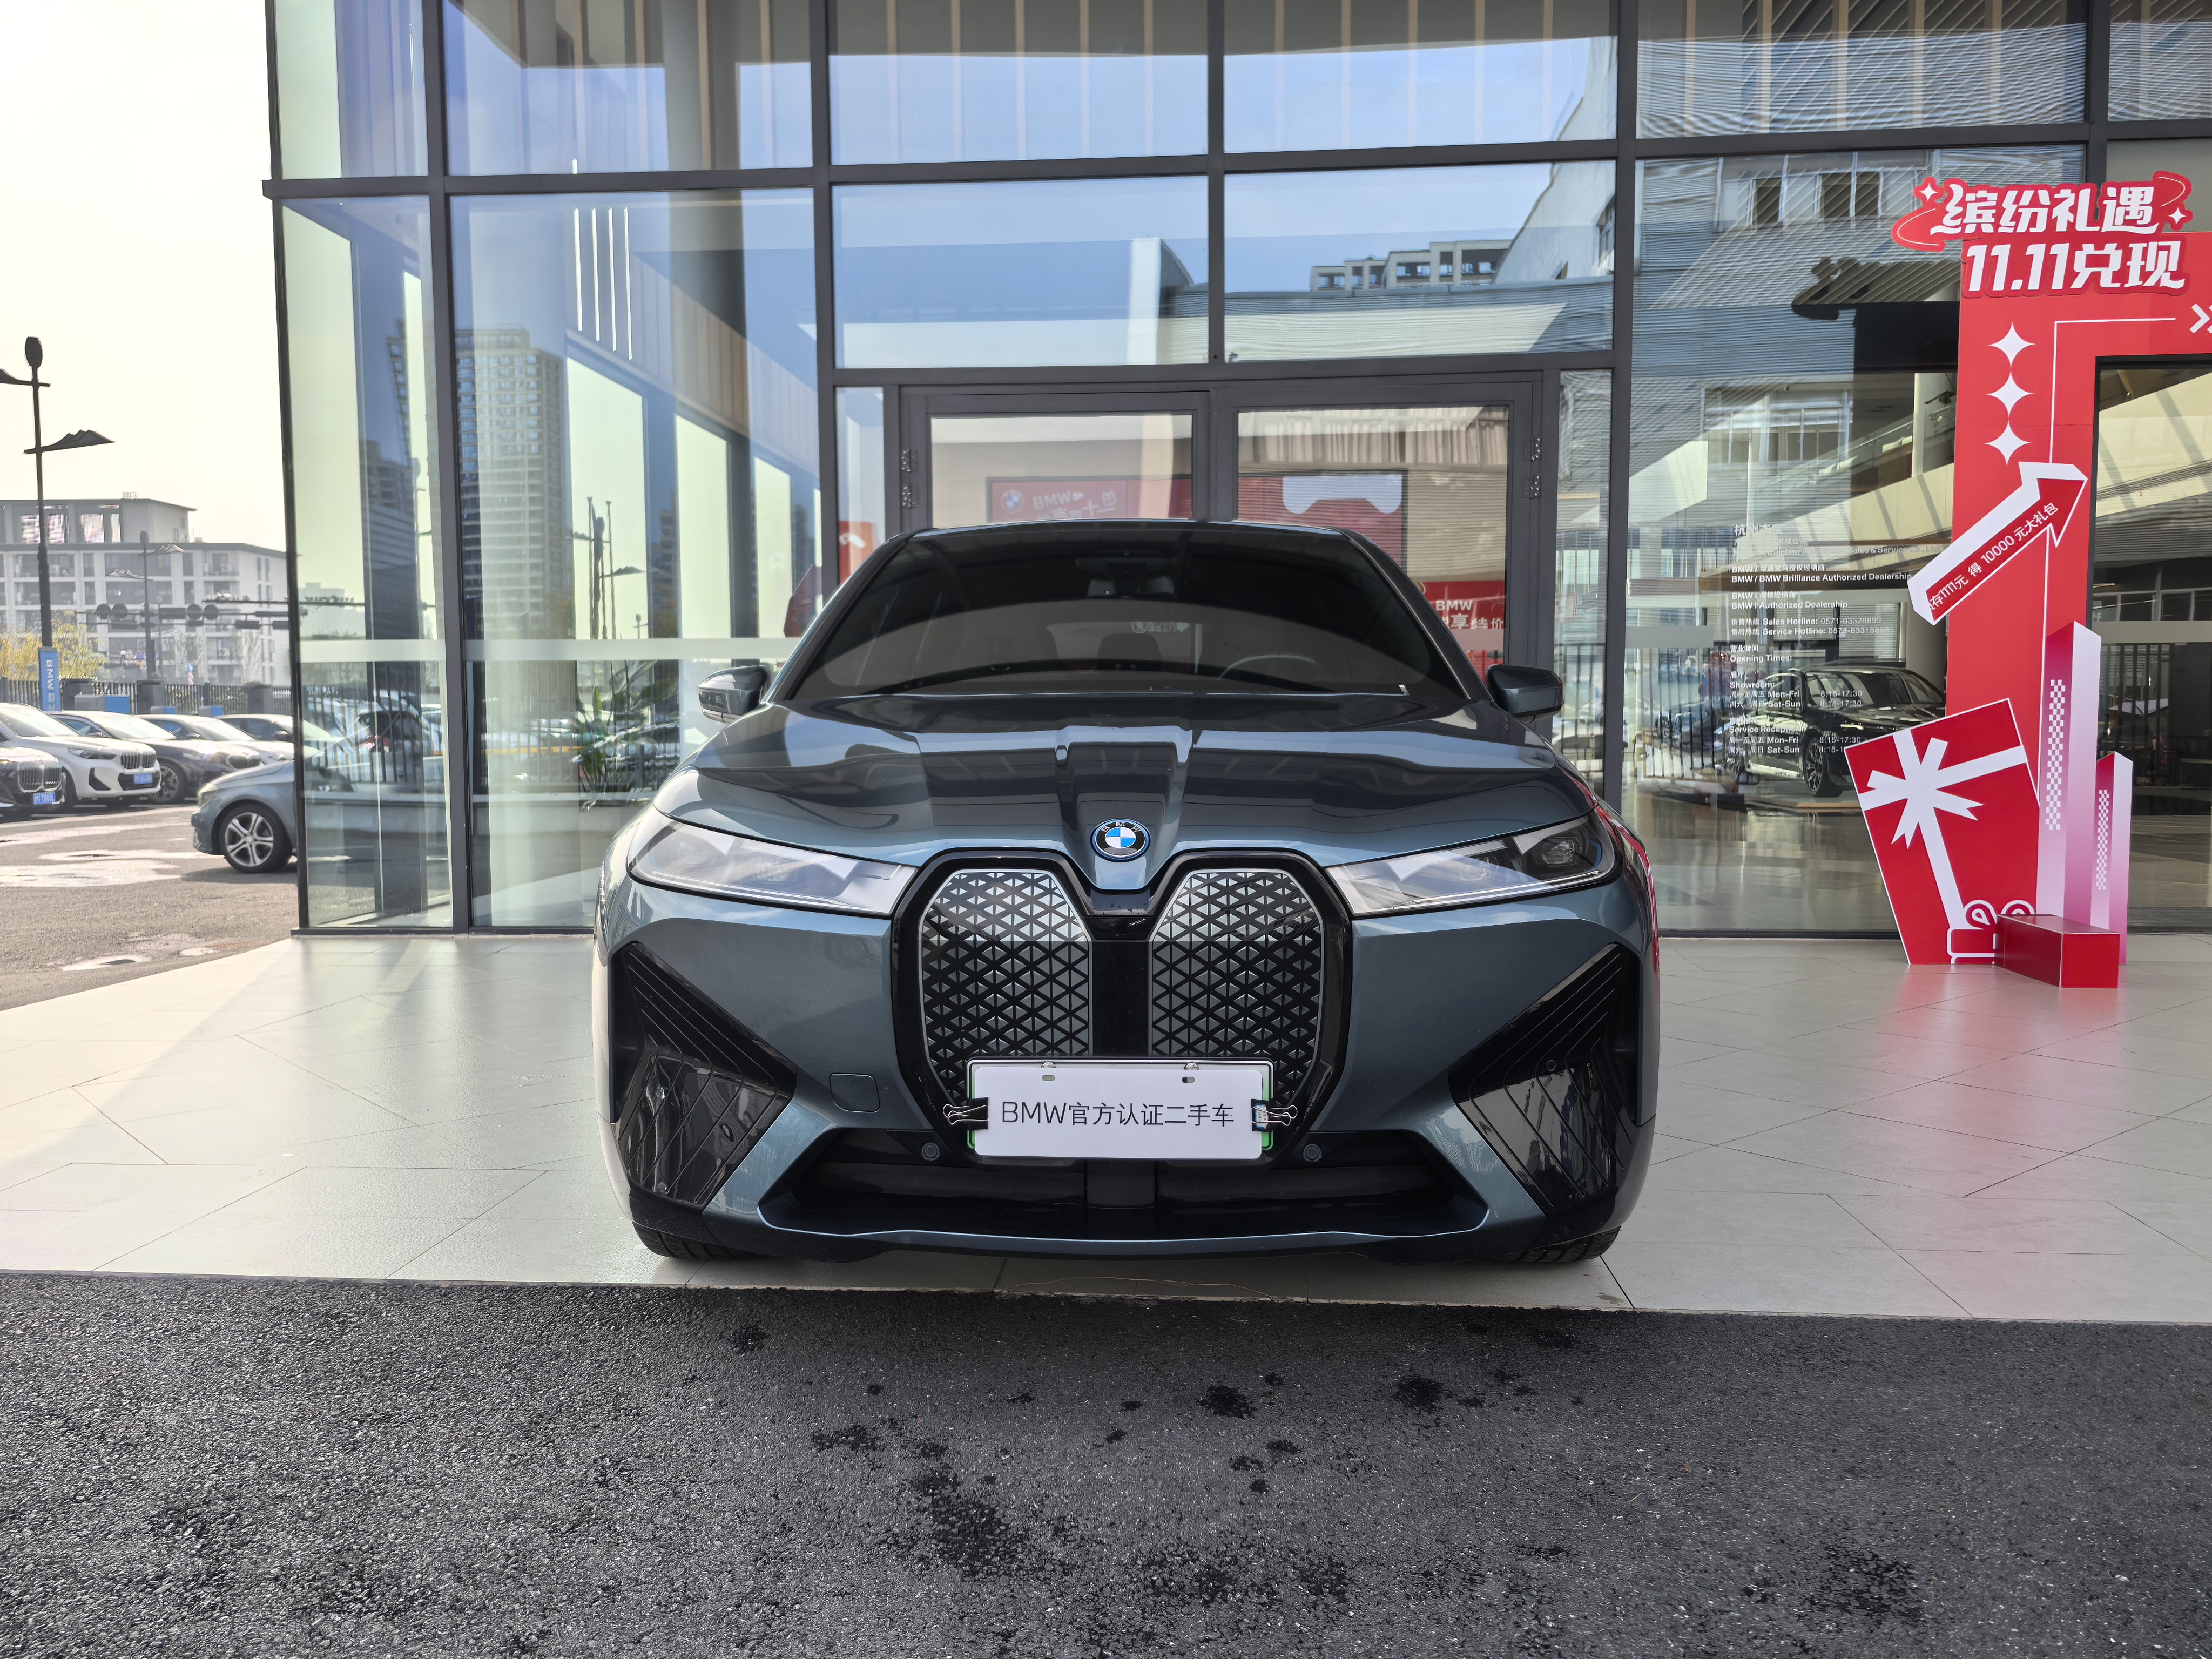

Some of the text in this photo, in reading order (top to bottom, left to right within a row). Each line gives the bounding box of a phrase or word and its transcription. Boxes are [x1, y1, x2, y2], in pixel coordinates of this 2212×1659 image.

[1930, 184, 2159, 234] 缤纷礼遇
[1966, 241, 2185, 291] 11.11兑现
[1033, 490, 1071, 510] BMW
[1930, 503, 2058, 610] 存1111元 得 10000 元大礼包
[1759, 575, 1781, 583] BMW
[1783, 574, 1820, 582] Brilliance
[1822, 573, 1866, 582] Authorized
[1435, 599, 1473, 611] BMW
[1759, 601, 1803, 609] Authorized
[1805, 600, 1848, 609] Dealership
[1763, 617, 1785, 625] Sales
[1787, 617, 1818, 625] Hotline:
[1762, 627, 1792, 635] Service
[1795, 626, 1825, 635] Hotline:
[1730, 654, 1792, 663] Opening Times:
[1730, 681, 1775, 689] Showroom:
[1768, 690, 1799, 698] Mon-Fri
[1768, 700, 1800, 708] Sat-Sun
[1766, 736, 1798, 744] Mon-Fri
[1767, 746, 1799, 754] Sat-Sun
[1001, 1101, 1235, 1128] BMW官方认证二手车
